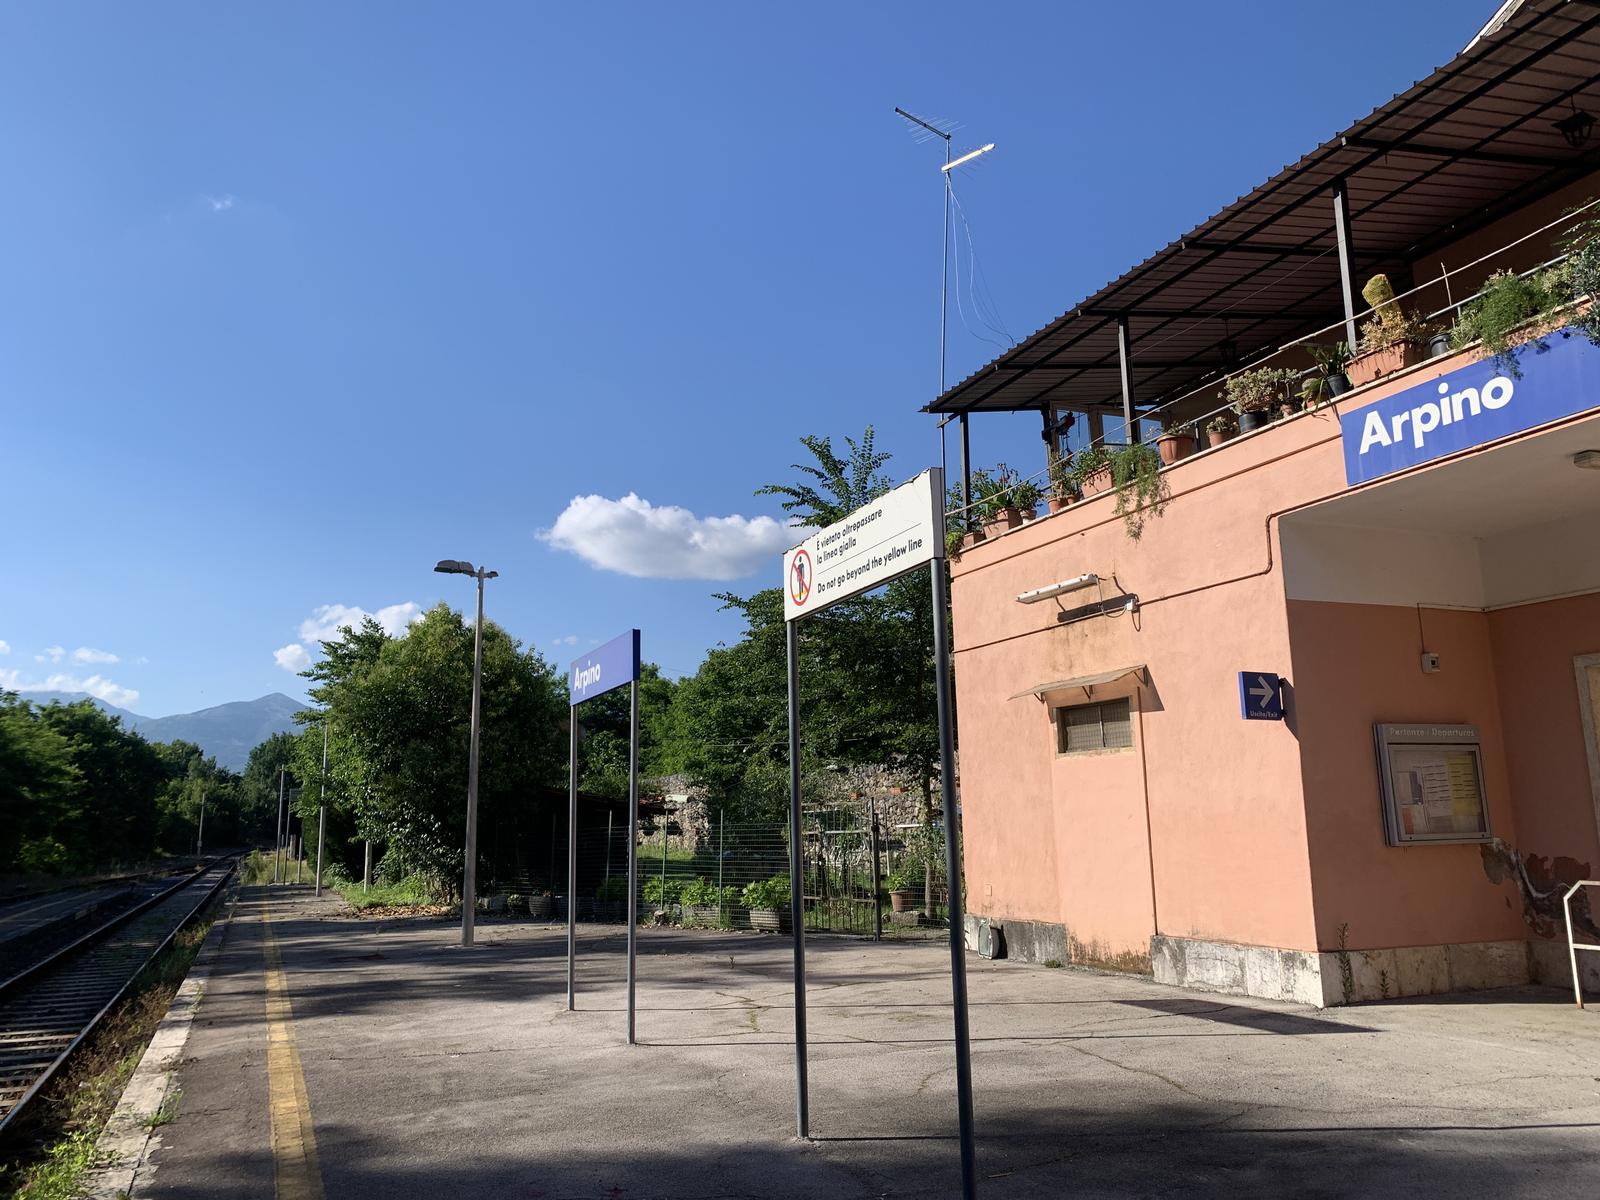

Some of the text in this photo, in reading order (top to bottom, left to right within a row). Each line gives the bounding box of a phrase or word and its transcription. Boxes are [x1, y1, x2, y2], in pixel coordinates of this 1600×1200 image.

[1359, 376, 1514, 455] Arpino
[821, 532, 841, 548] vietato
[842, 509, 883, 537] oltrepassare
[817, 537, 857, 565] la linea gialla
[817, 538, 923, 594] Do not go beyond the yellow line
[574, 660, 601, 695] Arpino
[1390, 728, 1425, 737] Partenze
[1432, 728, 1475, 739] Departures
